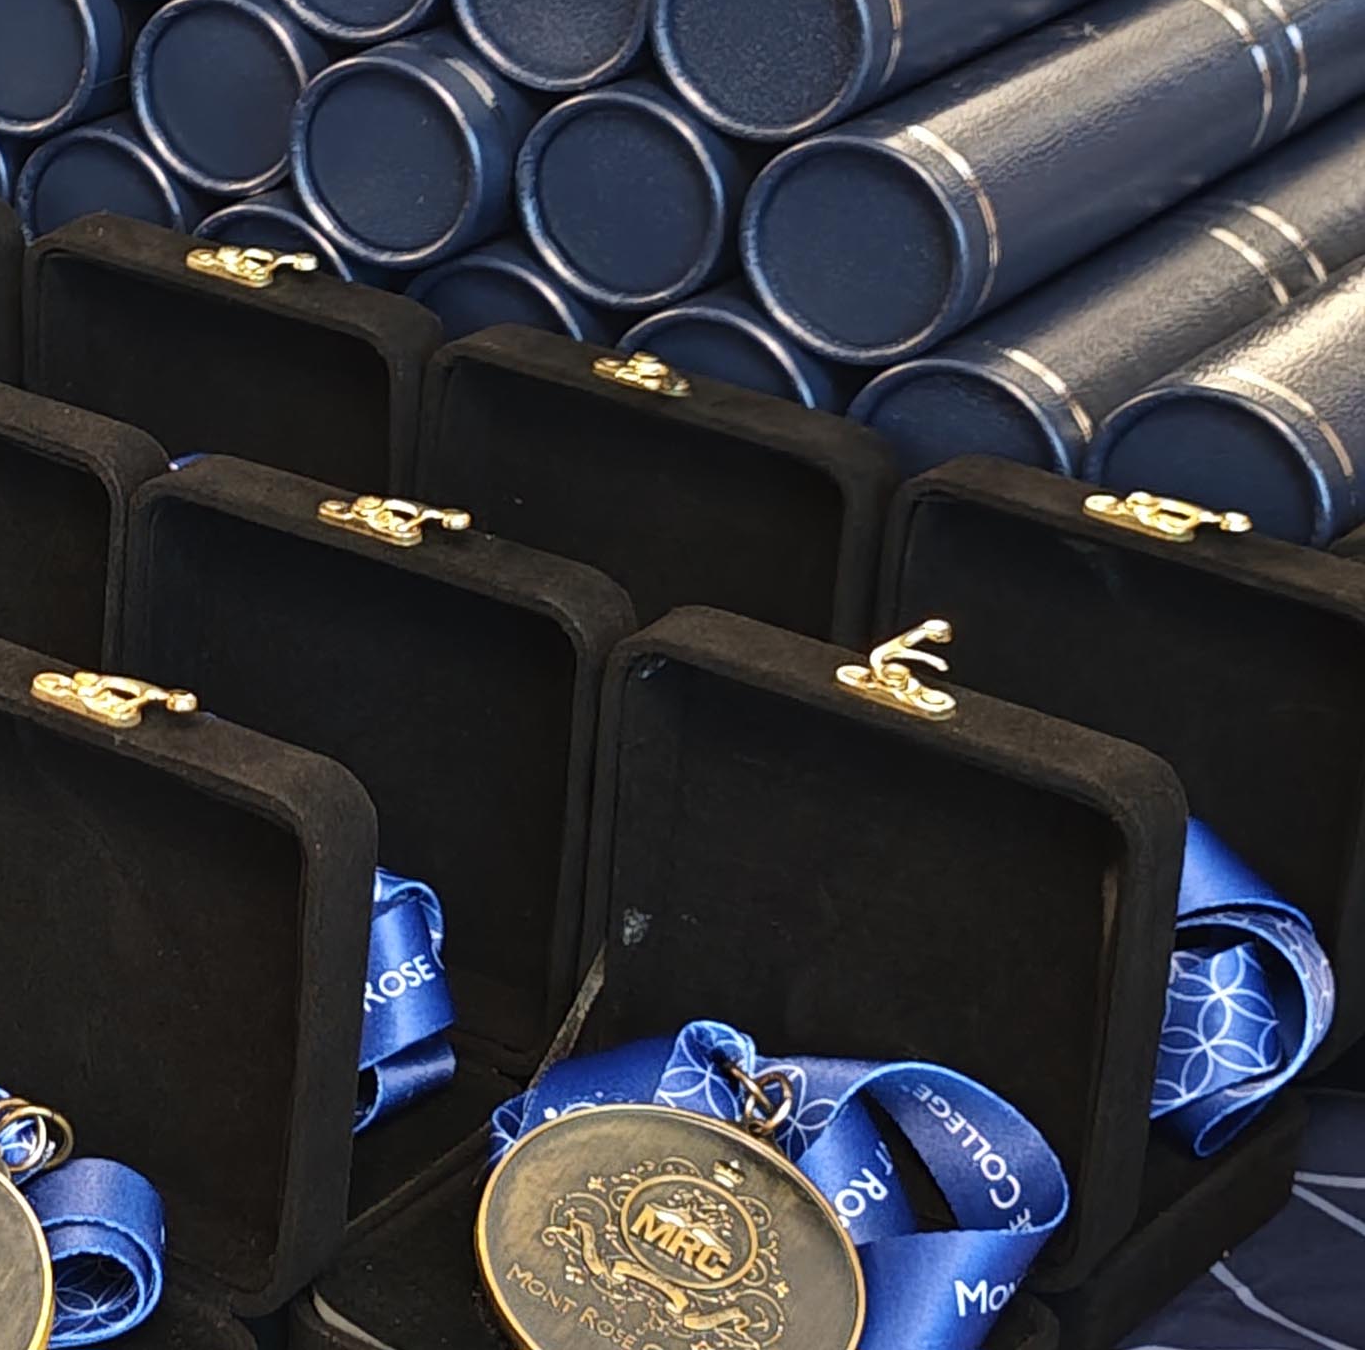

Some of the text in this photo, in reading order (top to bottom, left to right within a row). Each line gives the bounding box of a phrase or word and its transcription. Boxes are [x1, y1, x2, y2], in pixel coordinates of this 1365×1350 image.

[912, 1083, 1021, 1210] COLLEGE
[630, 1205, 732, 1280] MRC
[505, 1262, 639, 1350] MONT ROSE
